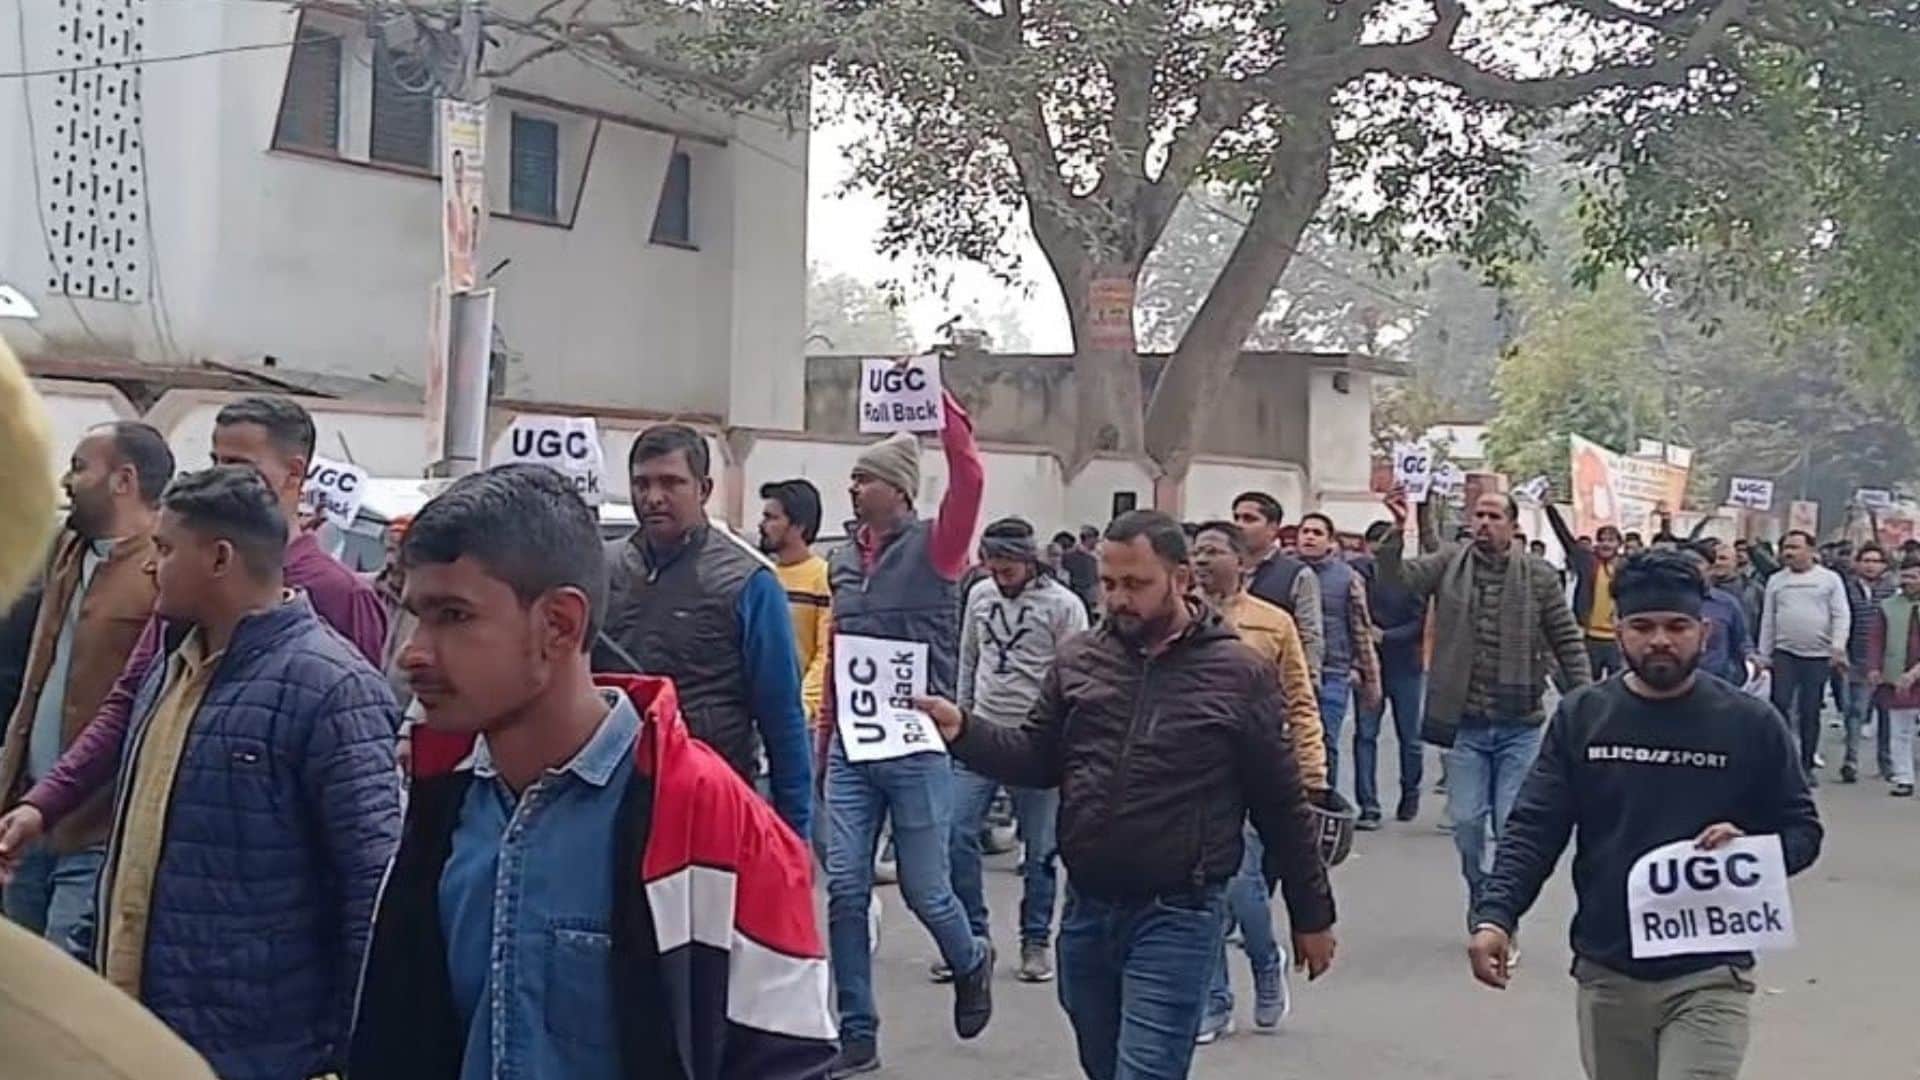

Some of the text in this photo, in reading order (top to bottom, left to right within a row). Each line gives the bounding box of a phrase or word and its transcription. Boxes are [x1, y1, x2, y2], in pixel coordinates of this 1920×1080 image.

[869, 367, 926, 393] UGC
[892, 399, 938, 421] Back
[512, 428, 588, 459] UGC
[1737, 482, 1769, 495] UGC
[848, 656, 886, 744] UGC
[889, 650, 930, 744] Roll Back
[1648, 853, 1762, 895] UGC
[1643, 901, 1783, 942] Roll Back
